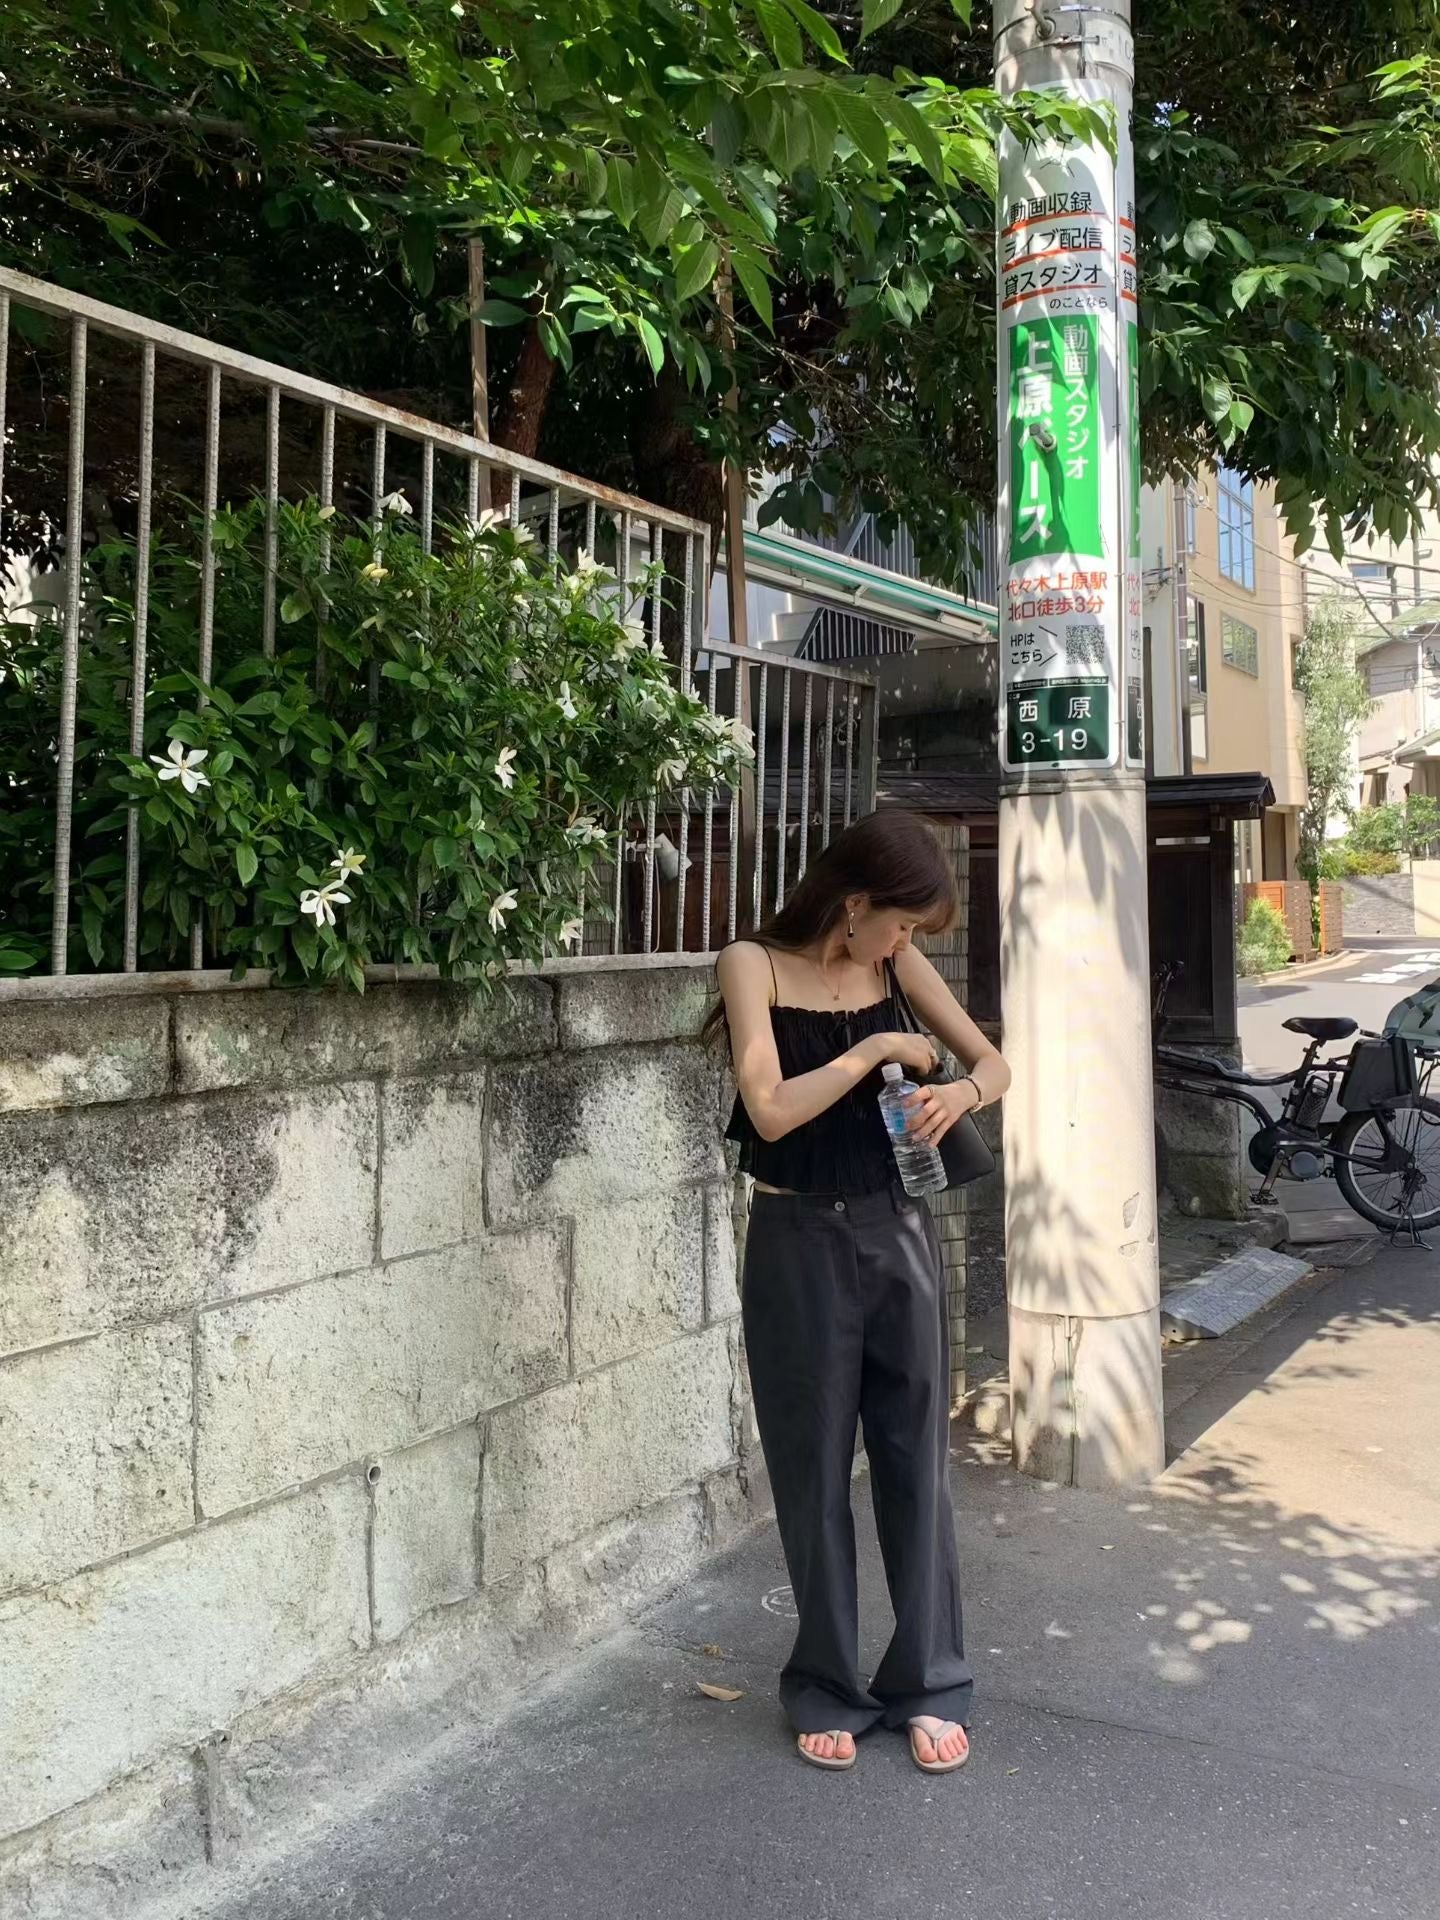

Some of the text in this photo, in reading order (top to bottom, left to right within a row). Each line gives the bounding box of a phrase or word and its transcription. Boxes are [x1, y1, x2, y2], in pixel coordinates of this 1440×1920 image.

[1009, 191, 1092, 223] 動画収録
[1005, 227, 1102, 262] ライブ配信
[1004, 263, 1102, 300] 貸スタジオ
[1050, 297, 1108, 309] のことなら
[1063, 324, 1089, 480] 動画スタジオ
[1006, 571, 1108, 599] 代々木上原駅
[1008, 597, 1105, 622] 北口徒歩3分
[1010, 632, 1035, 648] HPは
[1011, 649, 1043, 665] こちら
[1021, 728, 1088, 753] 3-19
